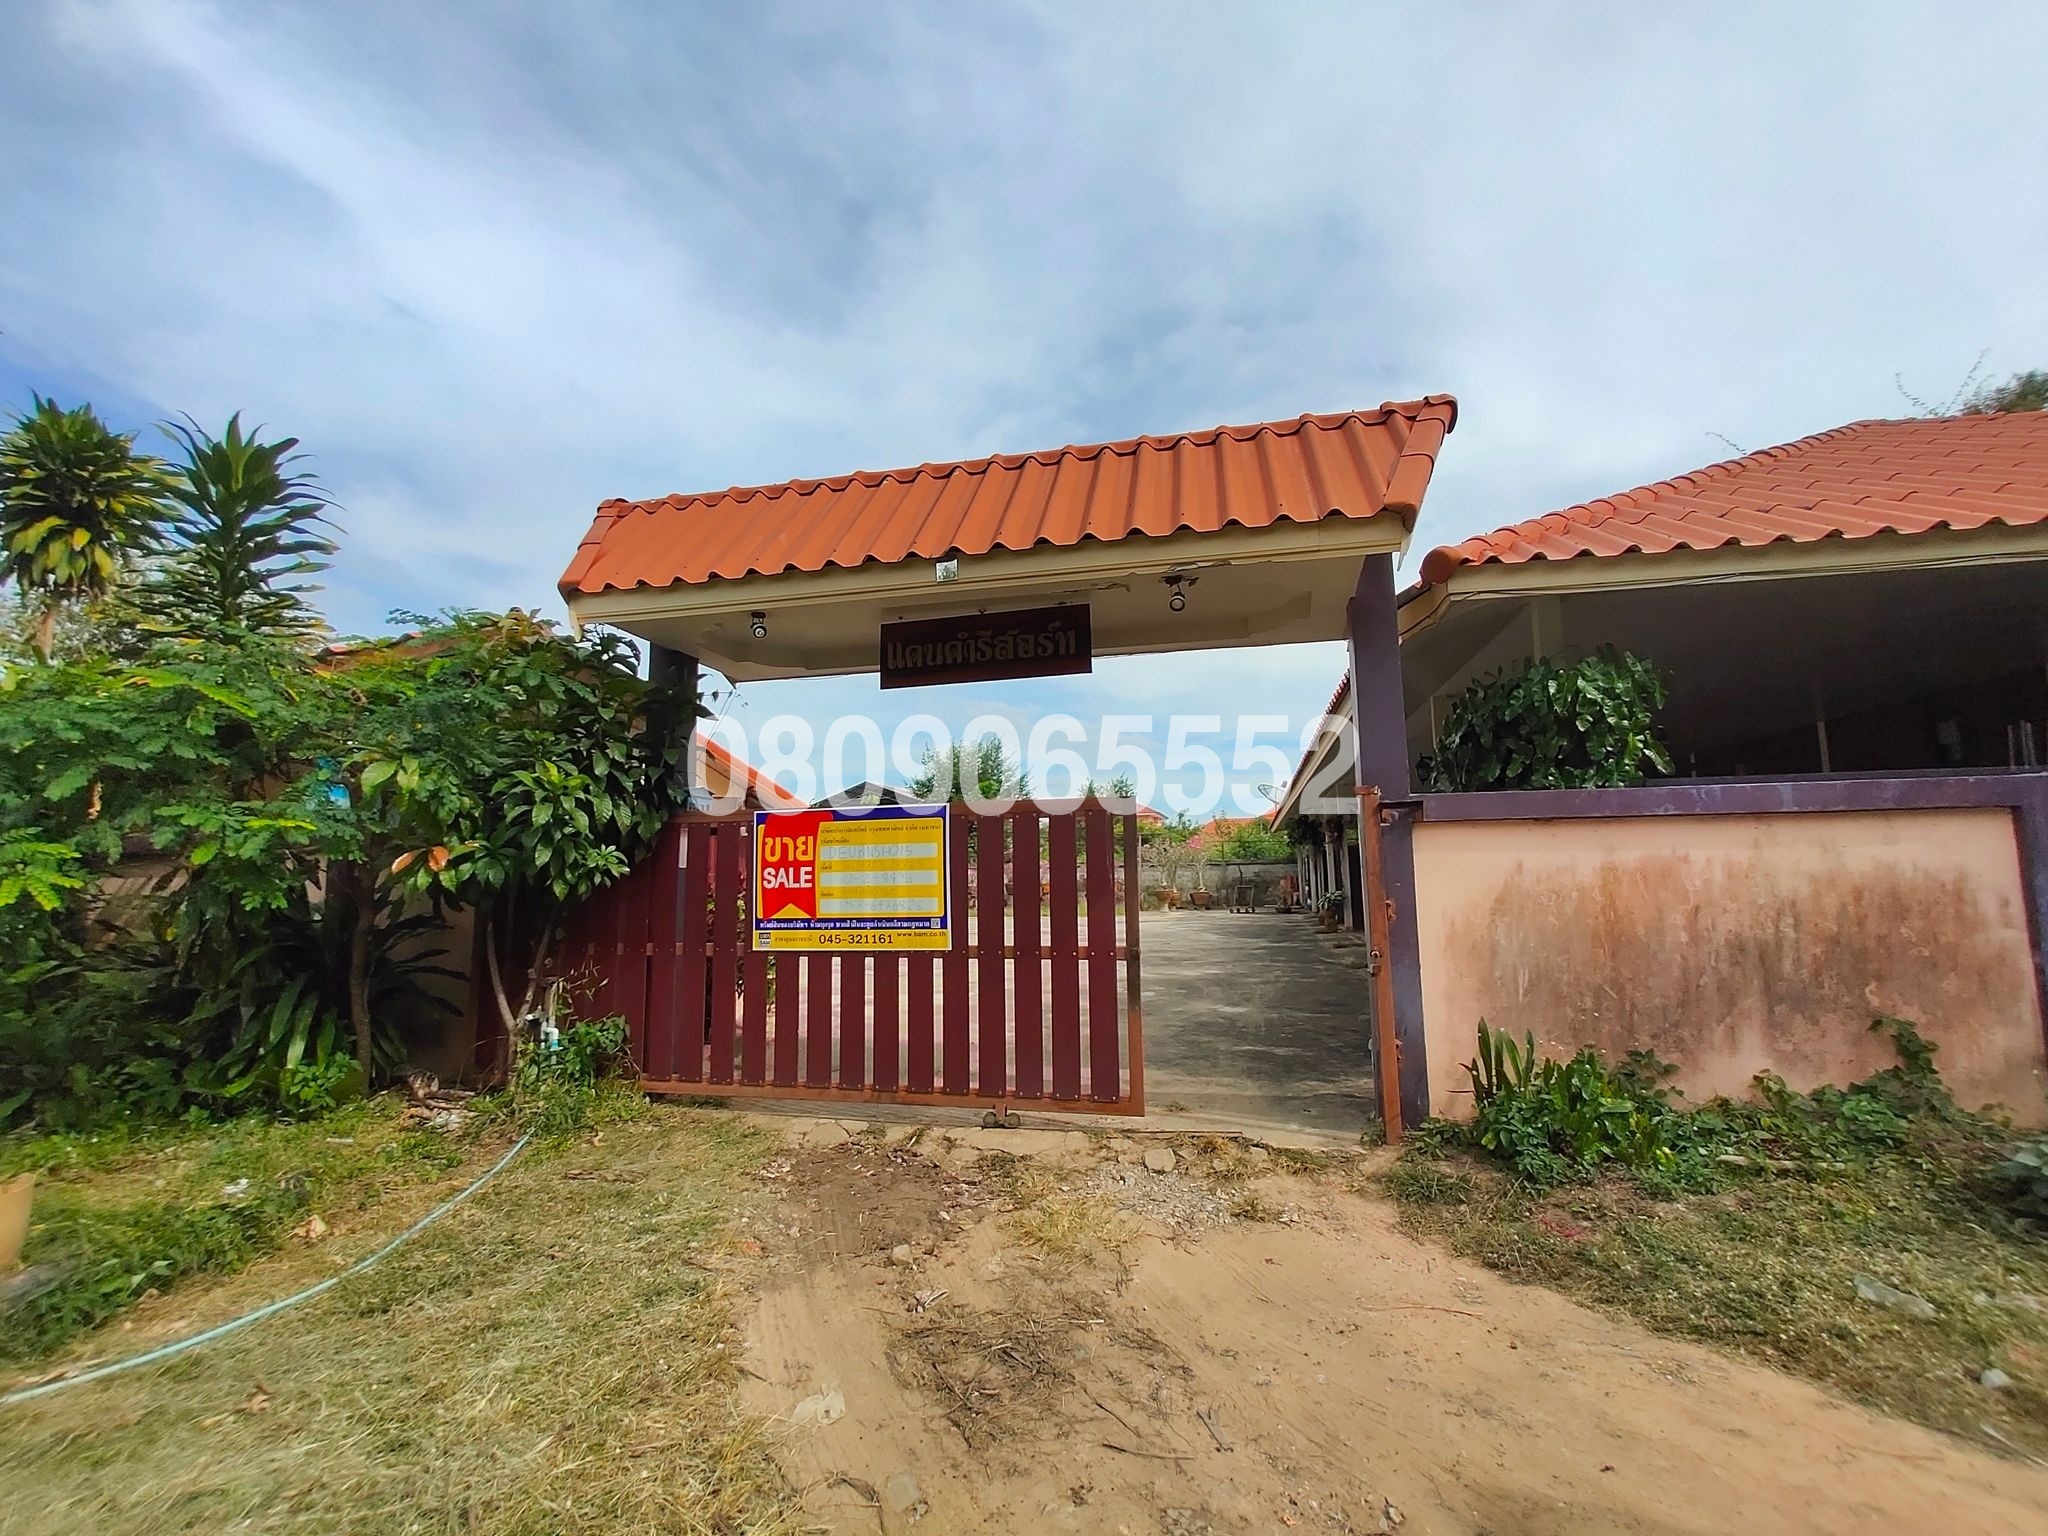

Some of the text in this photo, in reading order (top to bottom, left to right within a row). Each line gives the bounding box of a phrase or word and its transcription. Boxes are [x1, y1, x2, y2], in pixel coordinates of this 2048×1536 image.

[764, 836, 814, 863] ขาย
[763, 866, 813, 889] SALE
[819, 934, 894, 945] 045-321161
